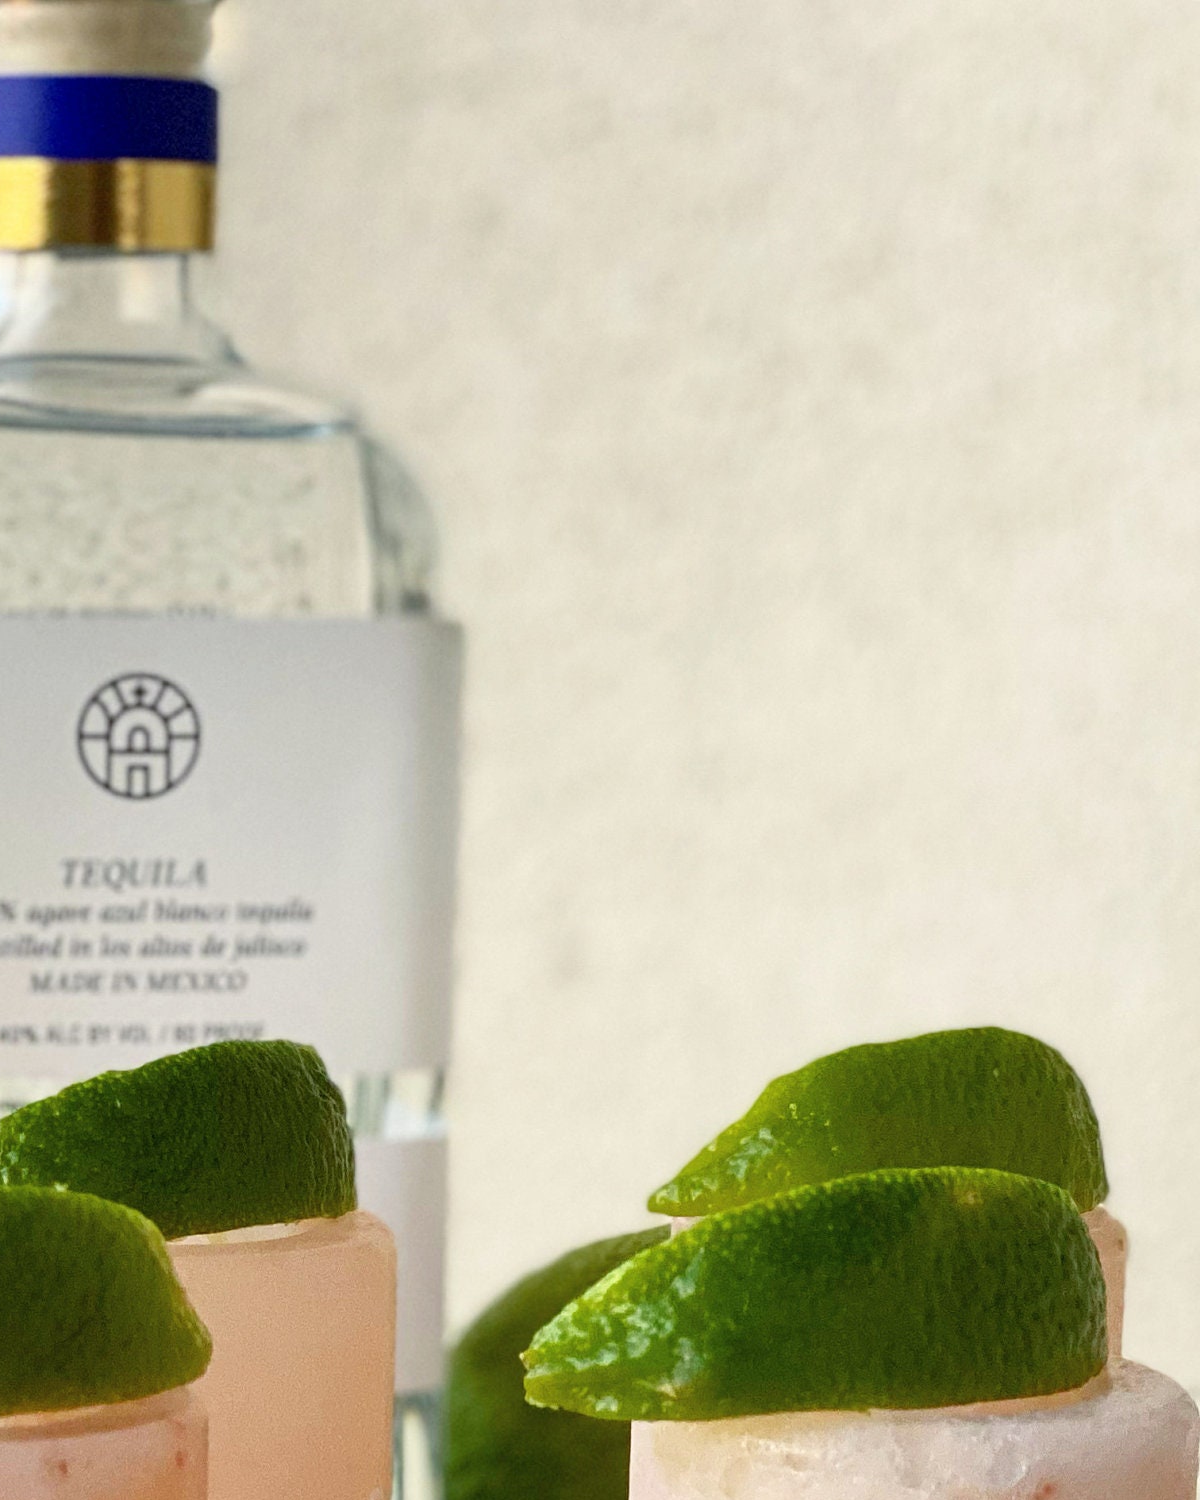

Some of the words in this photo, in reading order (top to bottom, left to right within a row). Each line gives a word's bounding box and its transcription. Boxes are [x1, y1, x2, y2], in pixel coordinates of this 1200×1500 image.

[59, 857, 208, 893] TEQUILA
[236, 898, 314, 925] tequila
[68, 938, 93, 958] in
[199, 934, 225, 958] de
[28, 968, 103, 994] MADE
[109, 970, 140, 994] IN
[146, 969, 249, 994] MEXICO
